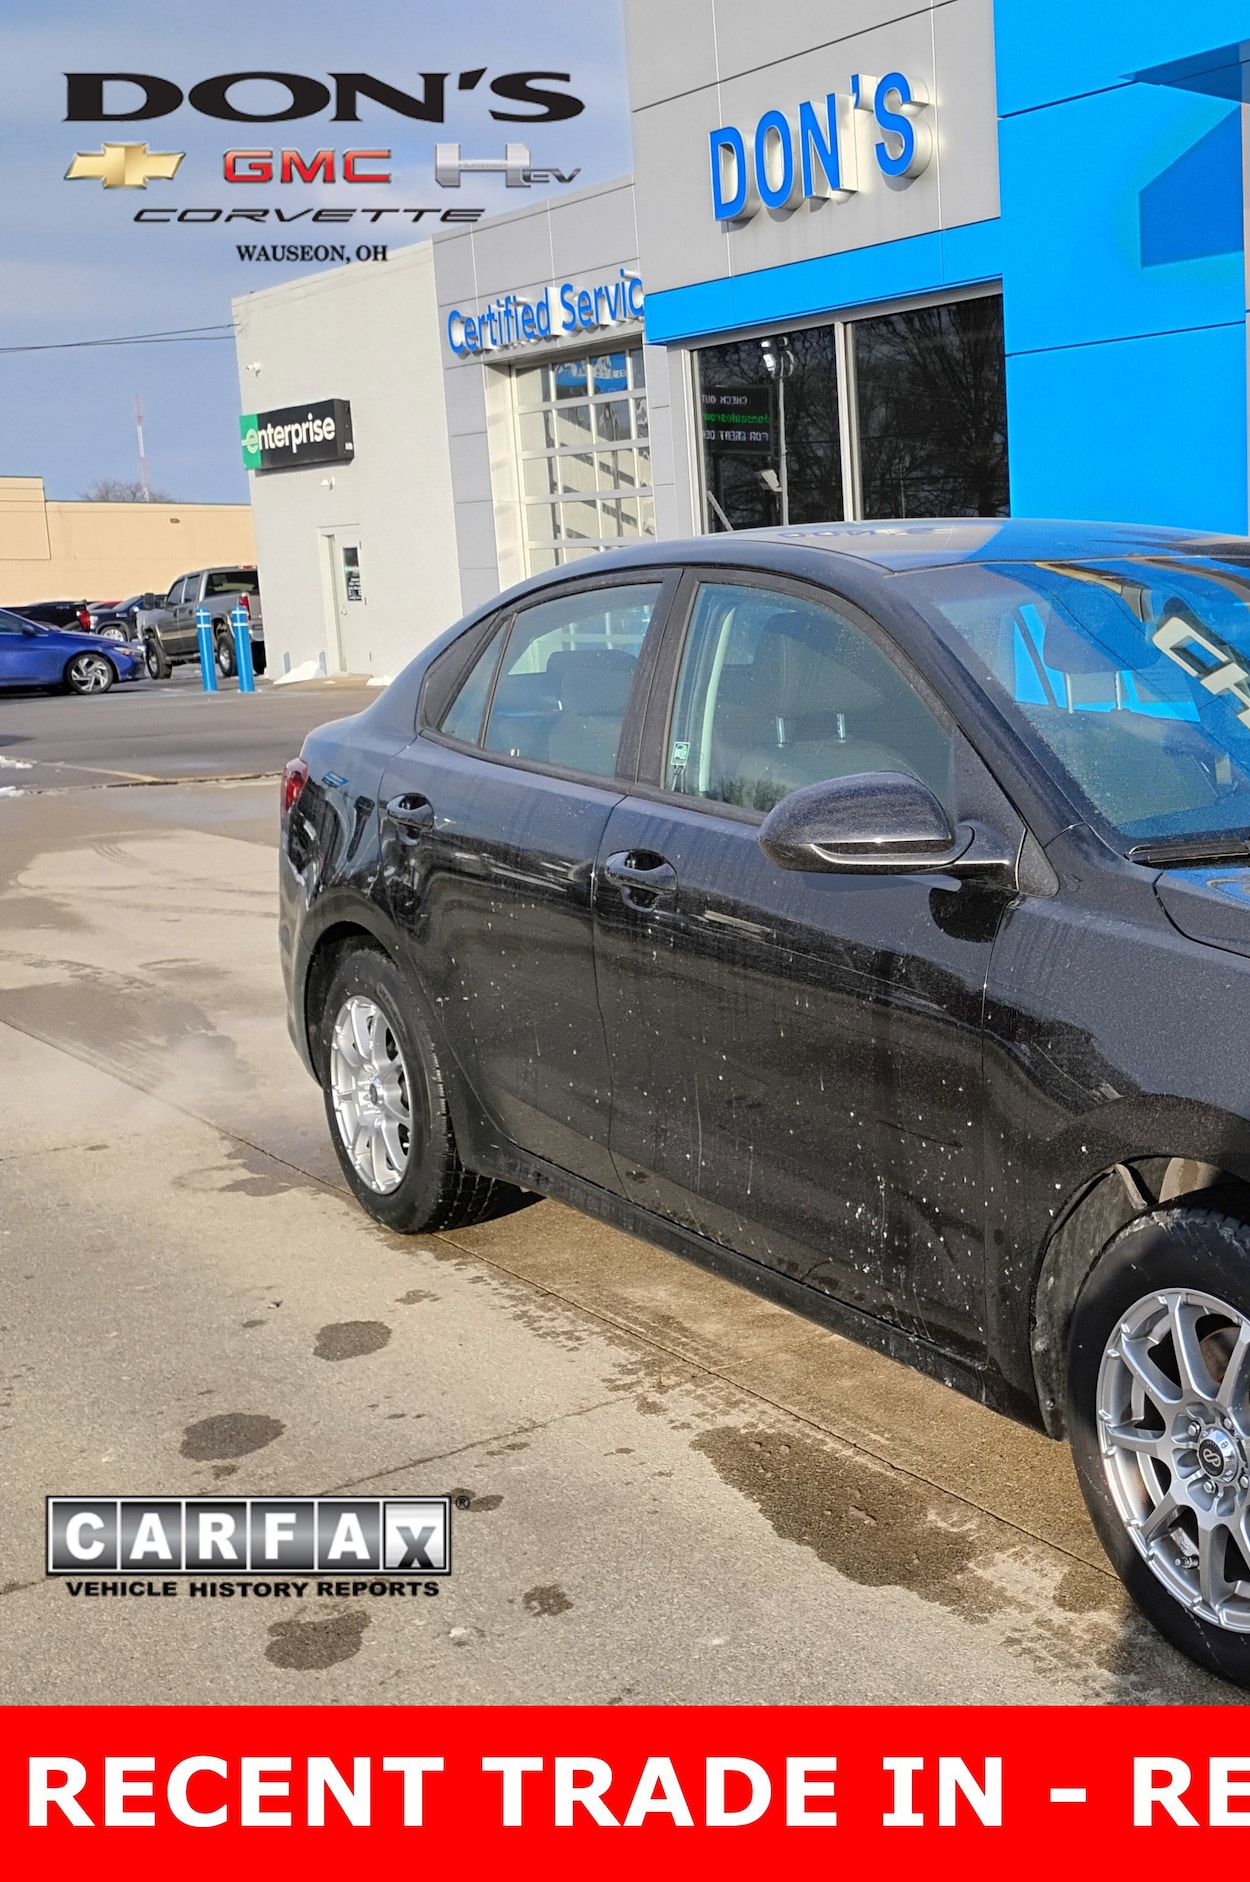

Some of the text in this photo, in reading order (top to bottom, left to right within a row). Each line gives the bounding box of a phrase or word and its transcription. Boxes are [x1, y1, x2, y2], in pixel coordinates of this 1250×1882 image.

[708, 71, 918, 222] DON'S
[448, 268, 645, 354] Certified Servic
[241, 412, 336, 454] enterprise
